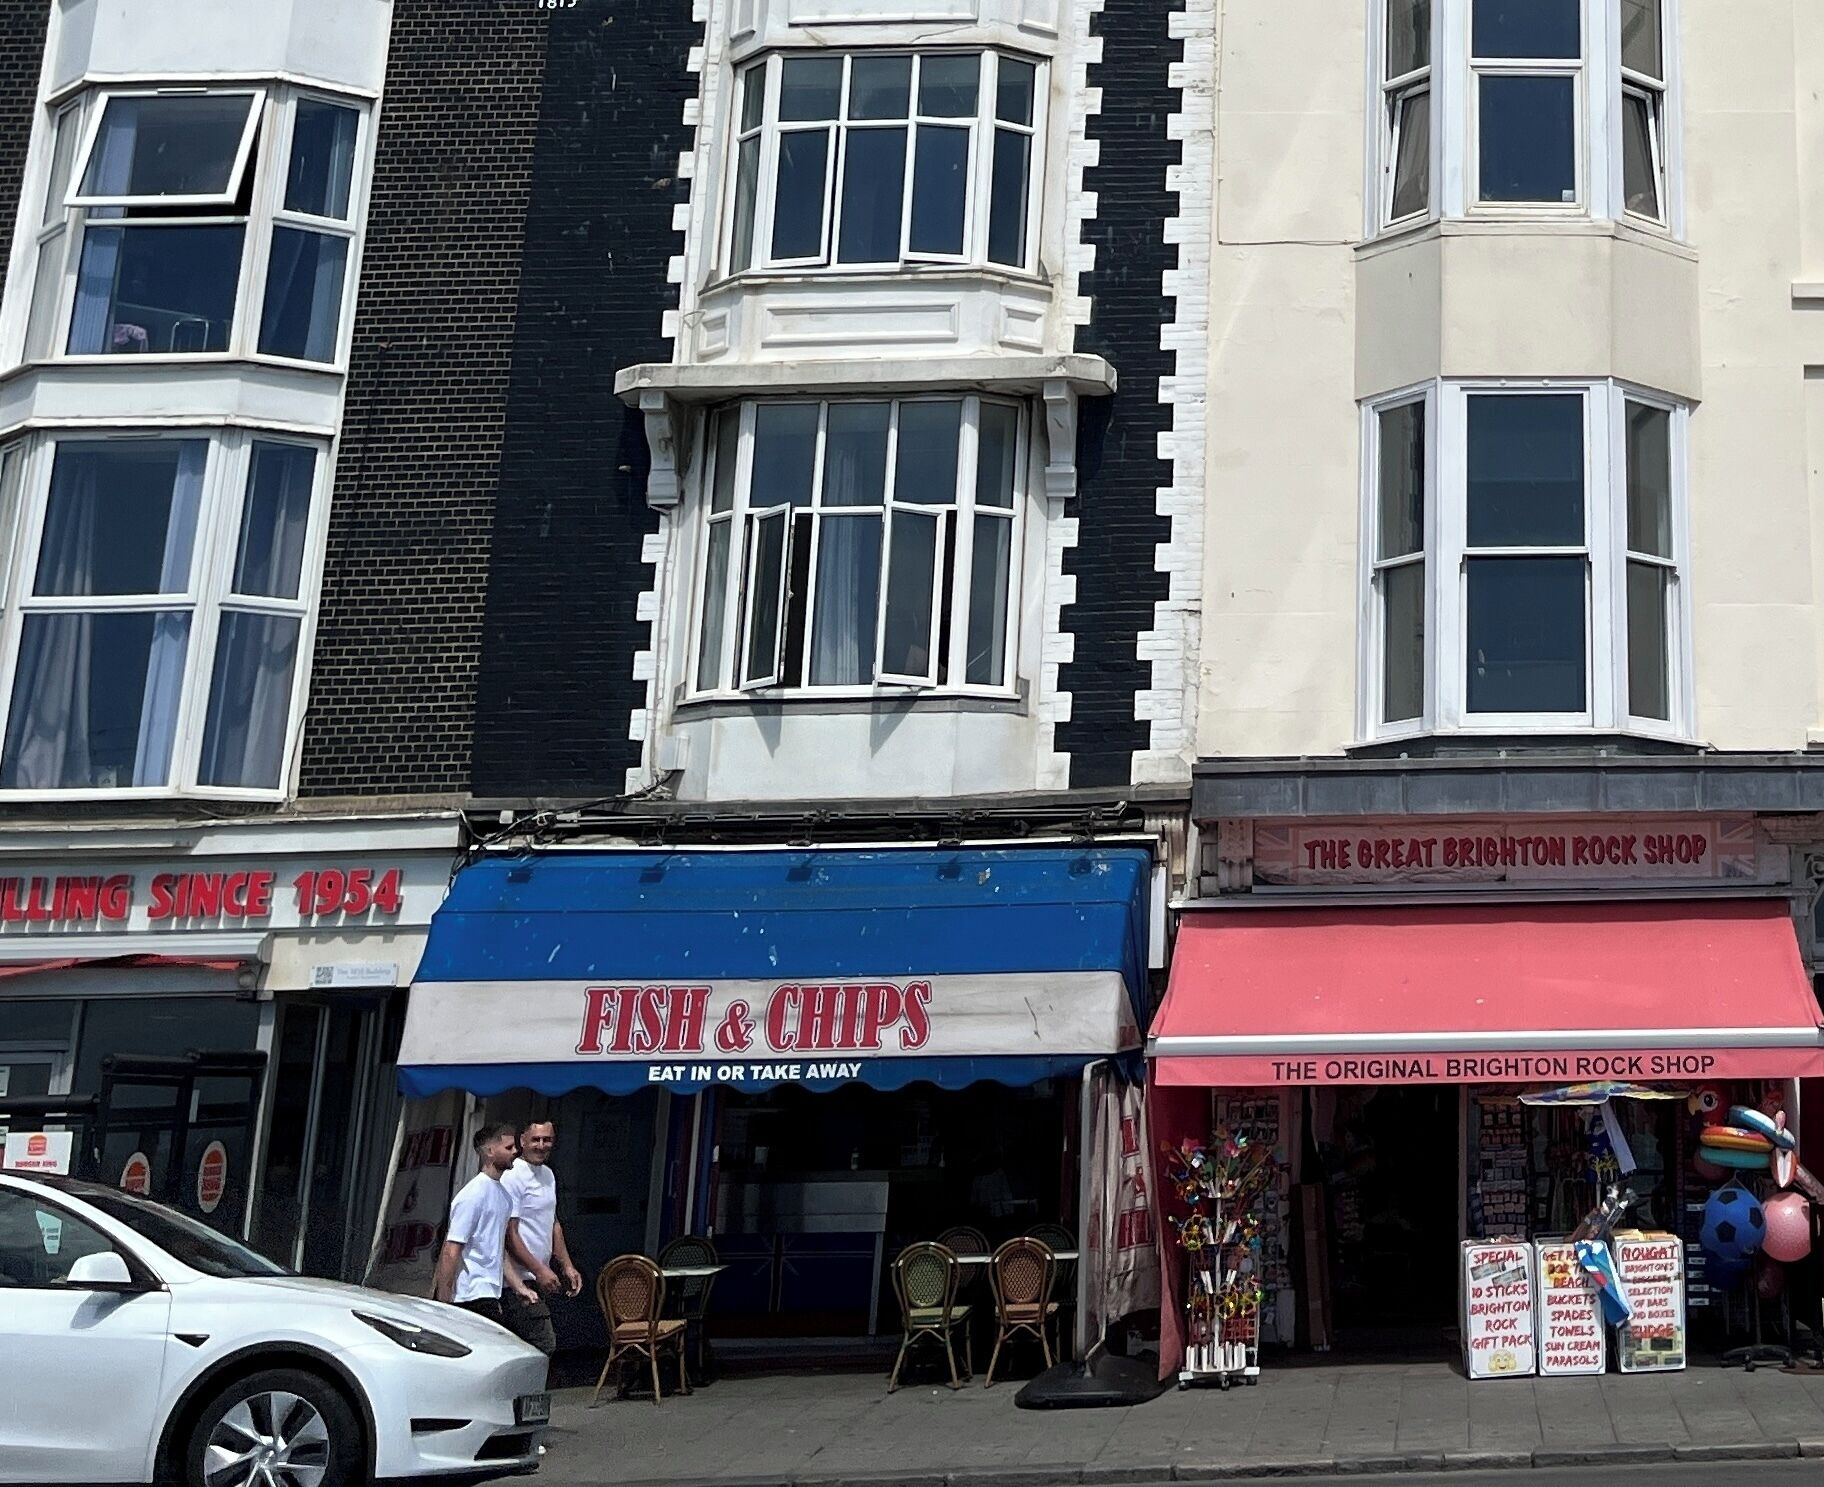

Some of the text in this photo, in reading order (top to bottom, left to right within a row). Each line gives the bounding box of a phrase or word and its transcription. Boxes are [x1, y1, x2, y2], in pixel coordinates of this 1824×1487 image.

[1304, 833, 1708, 870] THE GREAT BRIGHTON ROCK SHOP
[147, 869, 274, 921] SINCE
[292, 866, 402, 918] 1954
[576, 980, 933, 1055] FISH & CHIPS
[648, 1062, 862, 1082] EAT IN OR TAKE AWAY
[1272, 1054, 1716, 1081] THE ORIGINAL BRIGHTON ROCK SHOP
[1473, 1249, 1523, 1265] SPECIAL
[1543, 1250, 1565, 1261] GET
[1621, 1244, 1678, 1260] NOUGAT
[1553, 1276, 1589, 1289] BEACH
[1471, 1283, 1528, 1300] 10 STICKS
[1627, 1286, 1674, 1297] SELECTION
[1546, 1294, 1596, 1306] BUCKETS
[1633, 1298, 1668, 1308] OF BARS
[1470, 1300, 1531, 1315] BRIGHTON
[1632, 1309, 1675, 1320] ND BOXES
[1551, 1309, 1593, 1321] SPADES
[1485, 1318, 1518, 1332] ROCK
[1550, 1325, 1595, 1338] TOWELS
[1631, 1323, 1676, 1339] FUDGE
[1471, 1334, 1532, 1350] GIFT PACK
[1544, 1340, 1601, 1352] SUN CREAM
[1546, 1355, 1599, 1367] PARASOLS
